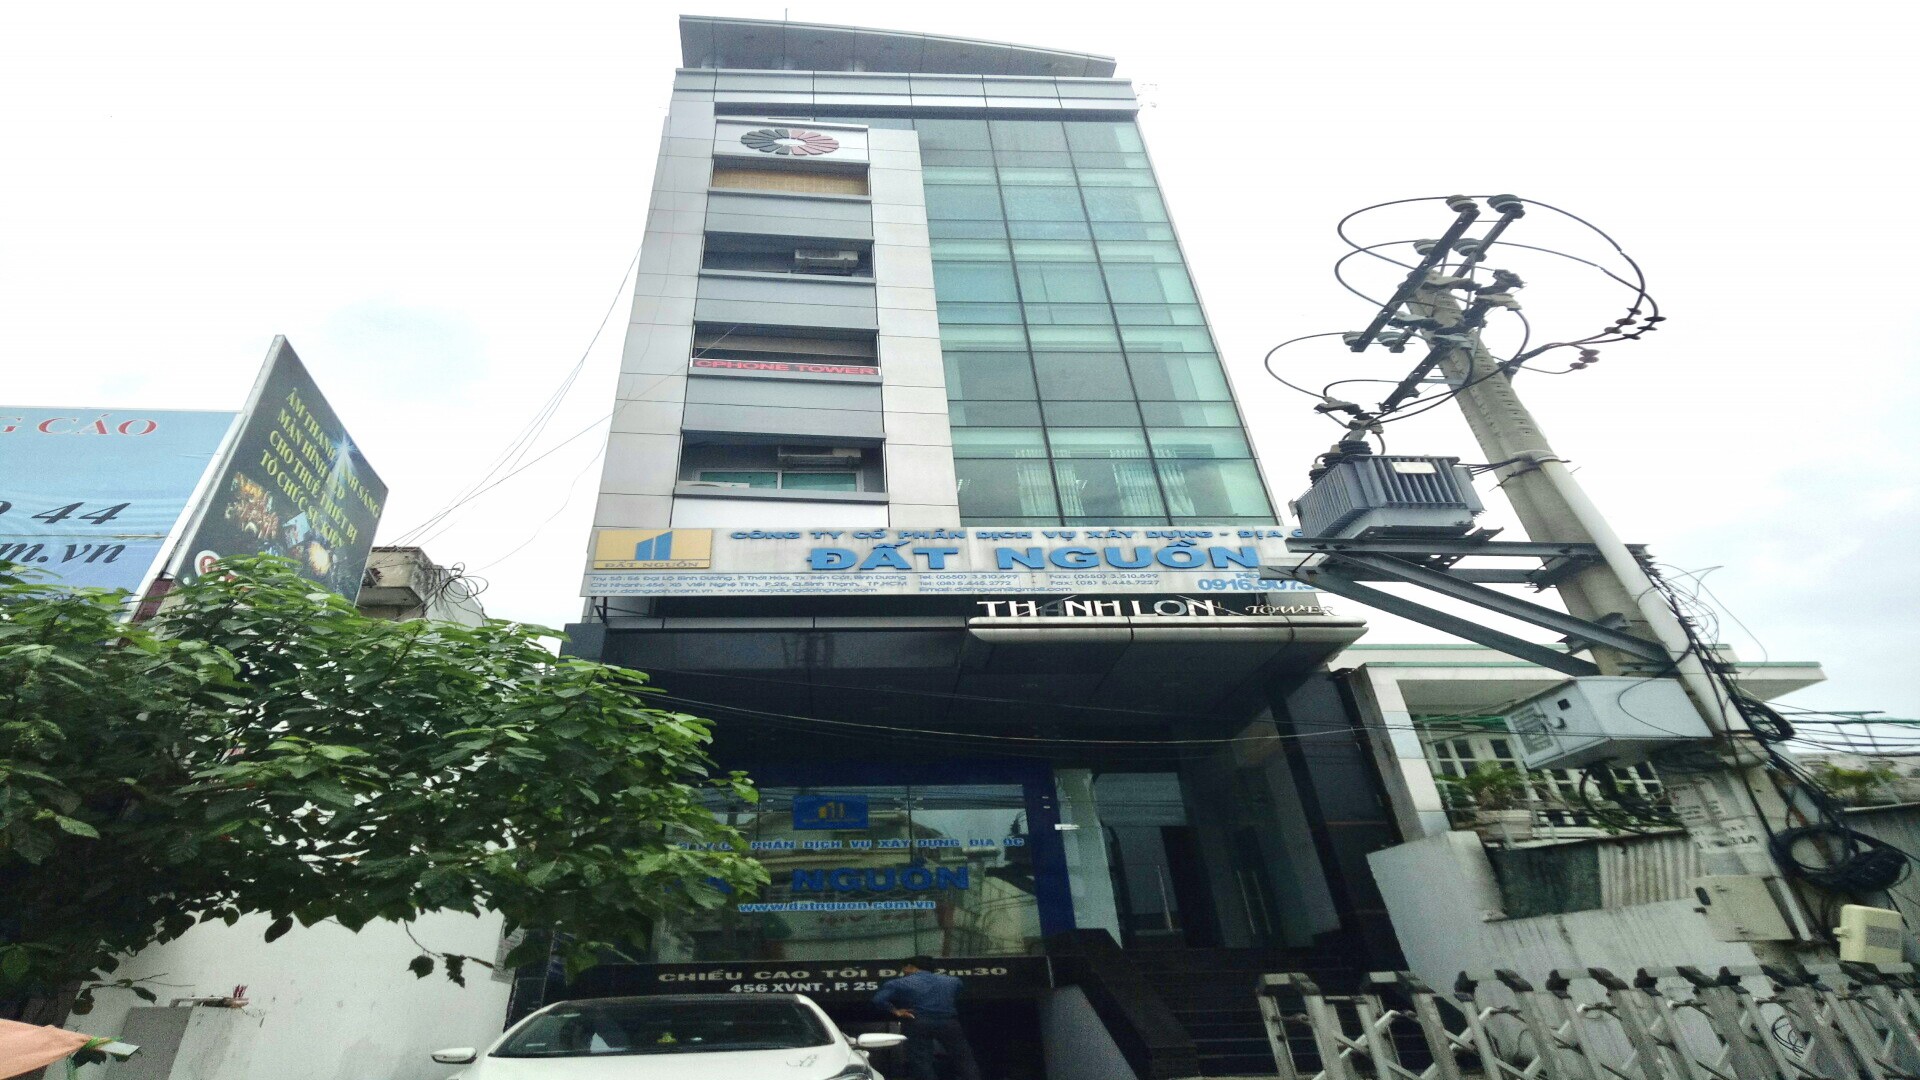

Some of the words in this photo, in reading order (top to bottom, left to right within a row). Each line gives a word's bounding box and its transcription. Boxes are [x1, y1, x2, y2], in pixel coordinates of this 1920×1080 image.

[795, 364, 876, 375] TOWER
[38, 413, 158, 435] CÁO
[304, 411, 337, 461] THANH
[269, 430, 294, 464] CHO
[31, 501, 132, 525] 44
[730, 530, 801, 540] CÔNG
[809, 530, 846, 540] TY
[852, 528, 888, 540] CỔ
[975, 530, 1033, 541] DỊCH
[1042, 530, 1077, 541] VỤ
[1086, 529, 1136, 539] XÂY
[1146, 529, 1213, 541] DỰNG
[1237, 530, 1284, 541] ĐỊA
[806, 540, 959, 571] ĐẤT
[994, 538, 1260, 570] NGUỒN
[1130, 600, 1234, 617] LON
[1245, 604, 1336, 616] TOWER
[802, 839, 843, 851] DỊCH
[849, 839, 873, 851] VỤ
[877, 837, 911, 848] XÂY
[737, 900, 936, 913] www.datnguon.com.vn
[753, 970, 811, 980] CAO
[729, 983, 769, 993] 456
[834, 982, 849, 991] P.
[852, 981, 879, 991] 25
